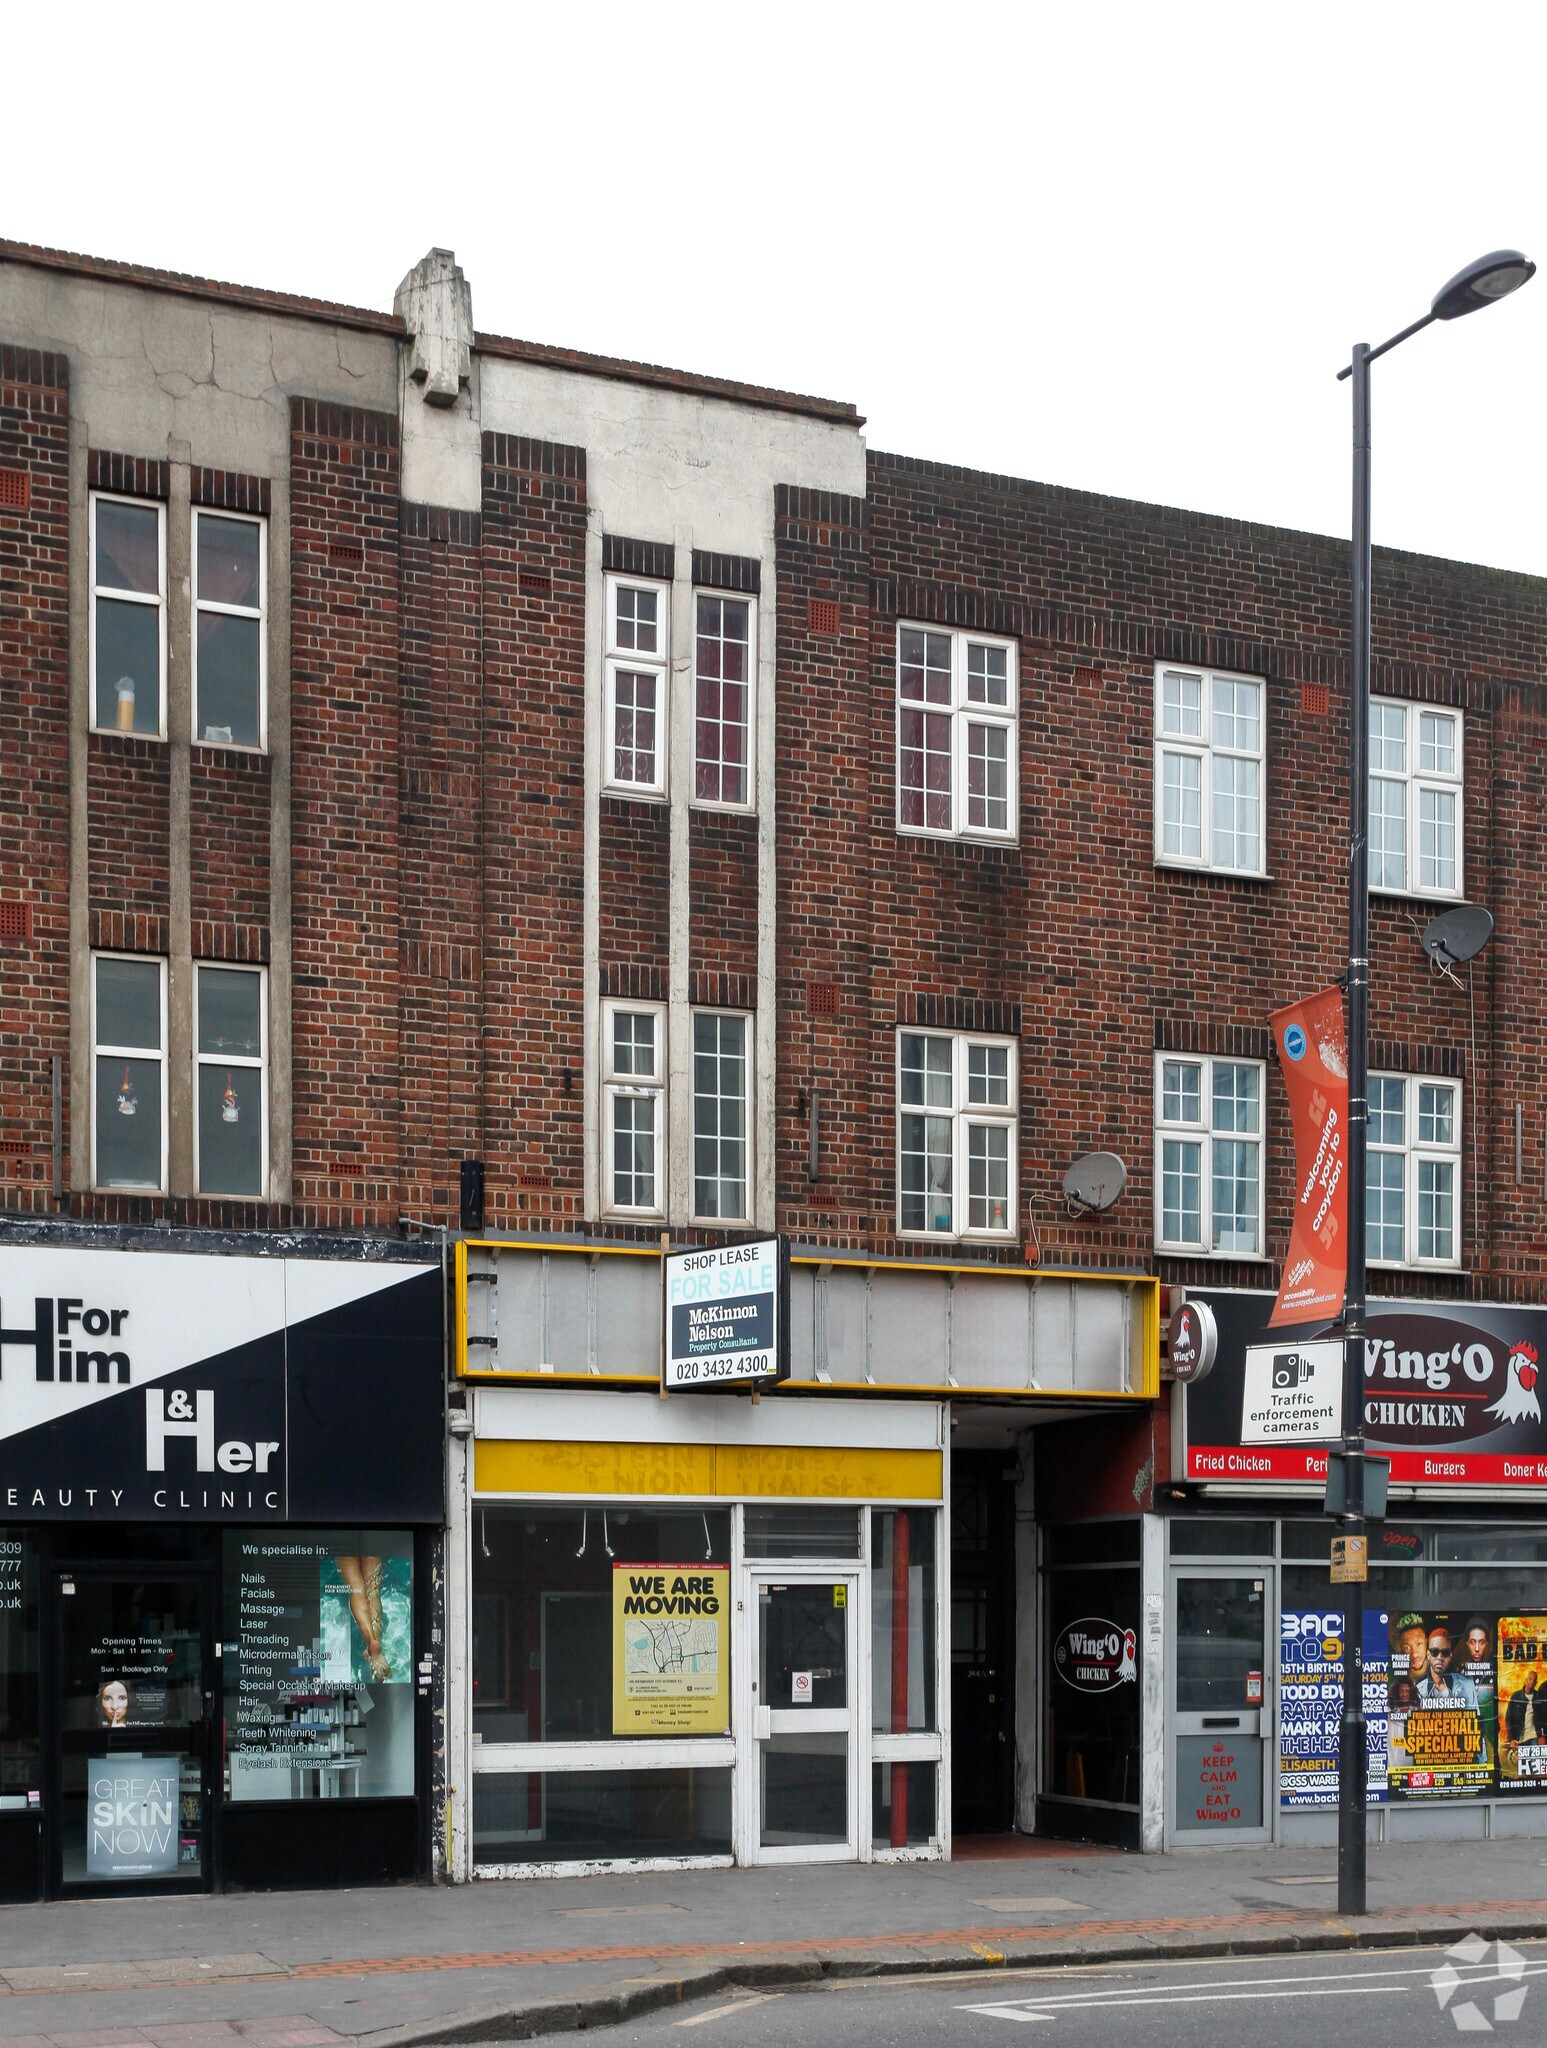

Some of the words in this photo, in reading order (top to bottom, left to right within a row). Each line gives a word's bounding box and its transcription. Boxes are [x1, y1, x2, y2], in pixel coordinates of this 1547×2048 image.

[1301, 1107, 1338, 1204] welcoming
[1319, 1153, 1334, 1188] you
[1330, 1132, 1340, 1153] to
[1312, 1159, 1343, 1232] croydon
[683, 1254, 716, 1271] SHOP
[719, 1247, 760, 1266] LEASE
[670, 1272, 712, 1302] FOR
[718, 1264, 774, 1295] SALE
[57, 1298, 129, 1336] For
[688, 1304, 758, 1326] McKinnon
[688, 1325, 734, 1342] Nelson
[688, 1341, 718, 1353] Property
[718, 1336, 758, 1349] Consultants
[676, 1362, 699, 1380] 020
[702, 1358, 733, 1377] 3432
[736, 1354, 768, 1374] 4300
[167, 1390, 194, 1419] &
[1271, 1393, 1314, 1406] Traffic
[1250, 1405, 1333, 1421] enforcement
[1364, 1401, 1466, 1427] CHICKEN
[146, 1389, 279, 1473] Her
[1263, 1421, 1319, 1433] cameras
[1195, 1454, 1225, 1470] Fried
[1228, 1454, 1271, 1471] Chicken
[1424, 1459, 1466, 1476] Burgers
[1503, 1462, 1534, 1477] Doner
[154, 1490, 278, 1508] CLINIC
[1383, 1531, 1417, 1548] open
[242, 1545, 259, 1555] We
[261, 1545, 313, 1556] specialise
[315, 1545, 329, 1555] in:
[241, 1573, 266, 1584] Nails
[629, 1576, 665, 1594] WE
[671, 1576, 715, 1594] ARE
[241, 1588, 275, 1599] Facials
[240, 1603, 285, 1616] Massage
[624, 1596, 719, 1614] MOVING
[240, 1618, 268, 1629] Laser
[1281, 1614, 1344, 1637] BAC
[102, 1638, 136, 1646] Opening
[240, 1633, 289, 1646] Threading
[1069, 1633, 1119, 1661] Wing'O
[1503, 1643, 1538, 1661] BAD
[239, 1649, 332, 1660] Microdermabrasion
[1391, 1654, 1410, 1662] PRINCE
[122, 1665, 152, 1674] Bookings
[153, 1665, 169, 1673] Only
[240, 1664, 272, 1676] Tinting
[1076, 1667, 1110, 1681] CHICKEN
[1281, 1662, 1304, 1673] 15TH
[1307, 1662, 1344, 1673] BIRTHD
[1362, 1662, 1388, 1672] ARTY
[1281, 1674, 1322, 1683] SATURDAY
[1370, 1673, 1389, 1682] 2016
[239, 1680, 274, 1691] Special
[277, 1680, 321, 1690] Occasion
[324, 1680, 366, 1692] Make-up
[1281, 1684, 1319, 1700] TODD
[239, 1696, 259, 1706] Hair
[1422, 1698, 1466, 1709] KONSHENS
[240, 1712, 276, 1724] Waxing
[1413, 1711, 1430, 1719] FRIDAY
[1432, 1711, 1442, 1719] 4TH
[1443, 1711, 1462, 1719] MARCH
[240, 1728, 266, 1738] Teeth
[268, 1728, 317, 1739] Whitening
[1281, 1721, 1322, 1736] MARK
[1407, 1718, 1481, 1736] DANCEHALL
[240, 1743, 268, 1755] Spray
[270, 1743, 308, 1754] Tanning
[1281, 1737, 1309, 1754] THE
[1406, 1736, 1460, 1753] SPECIAL
[1465, 1735, 1481, 1752] UK
[1518, 1747, 1530, 1757] SAT
[1531, 1747, 1540, 1757] 26
[239, 1759, 278, 1770] Eyelash
[279, 1759, 333, 1768] Extensions
[1203, 1756, 1234, 1767] KEEP
[1281, 1759, 1336, 1771] ELISABETH
[1200, 1771, 1237, 1783] CALM
[1281, 1776, 1307, 1787] @GSS
[94, 1778, 176, 1799] GREAT
[1206, 1794, 1230, 1806] EAT
[1196, 1808, 1241, 1821] Wing'O
[93, 1828, 172, 1855] NOW
